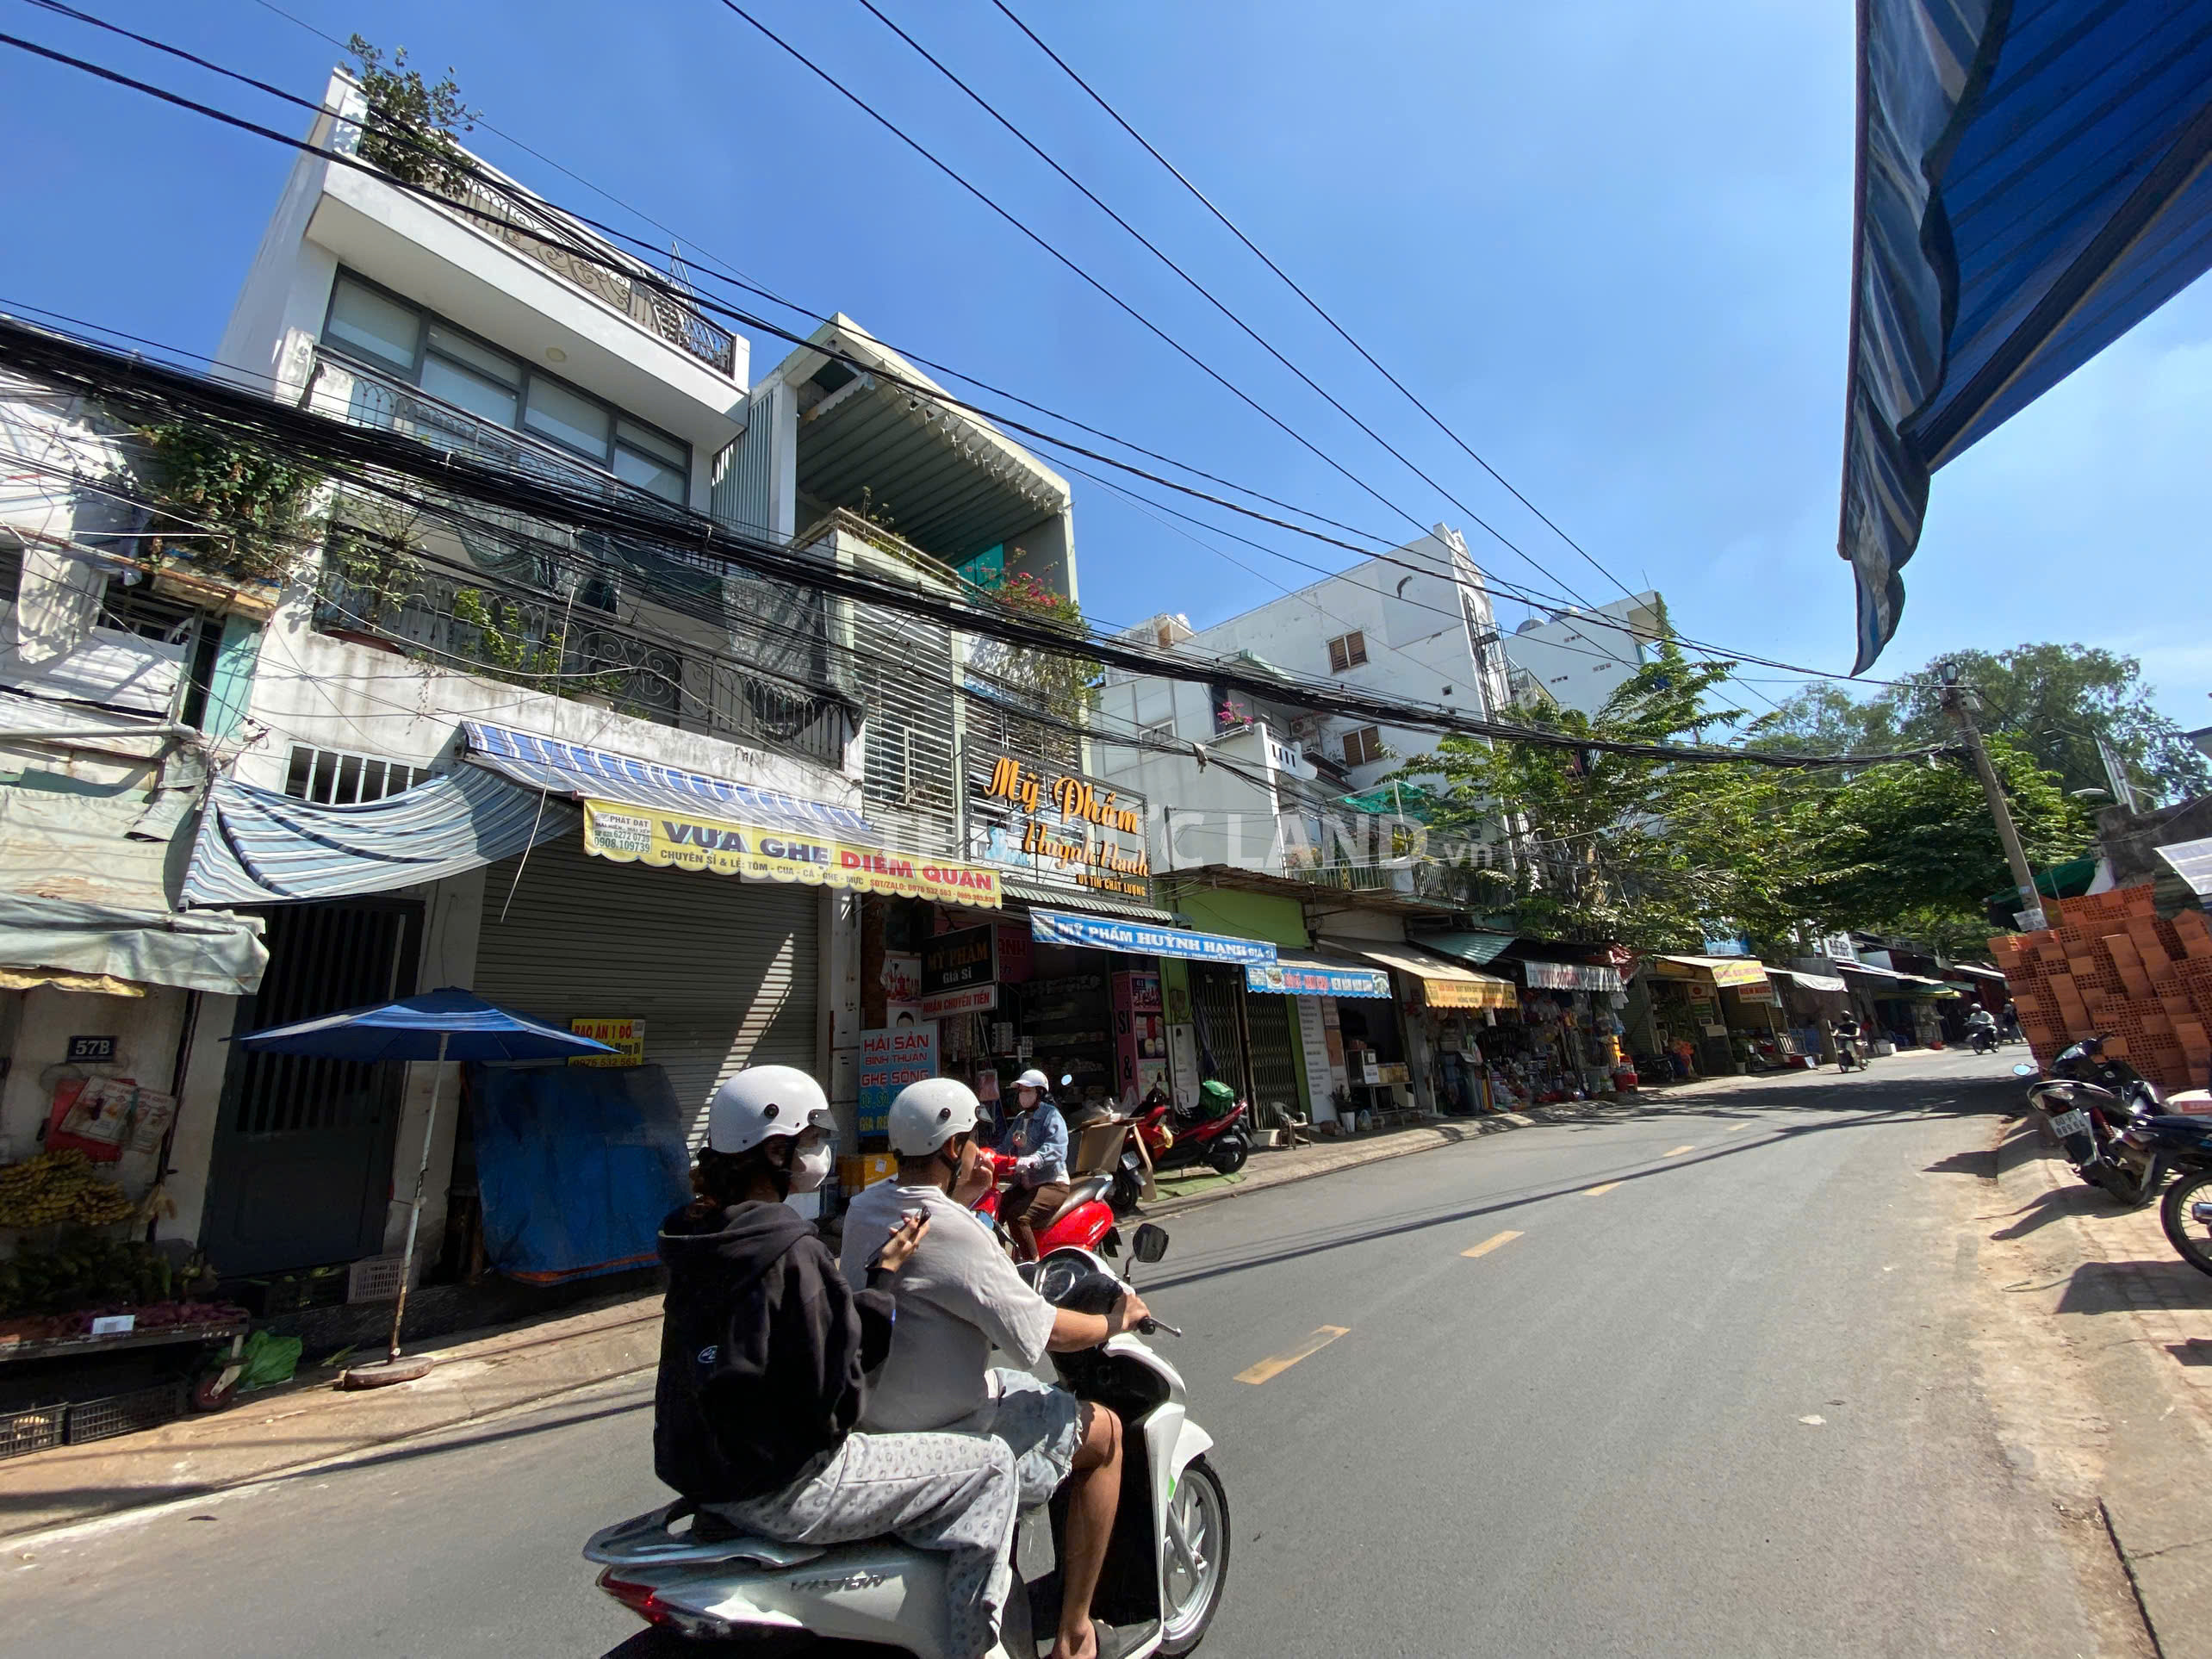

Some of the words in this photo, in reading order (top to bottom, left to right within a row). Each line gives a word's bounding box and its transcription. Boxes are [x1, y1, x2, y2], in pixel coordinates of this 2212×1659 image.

[983, 757, 1040, 813] Mỹ
[1053, 775, 1138, 834] Phẩm
[662, 820, 749, 854] VỰA
[1022, 821, 1096, 870] Huỳnh
[1100, 840, 1151, 879] Hạnh
[75, 1040, 110, 1055] 57B
